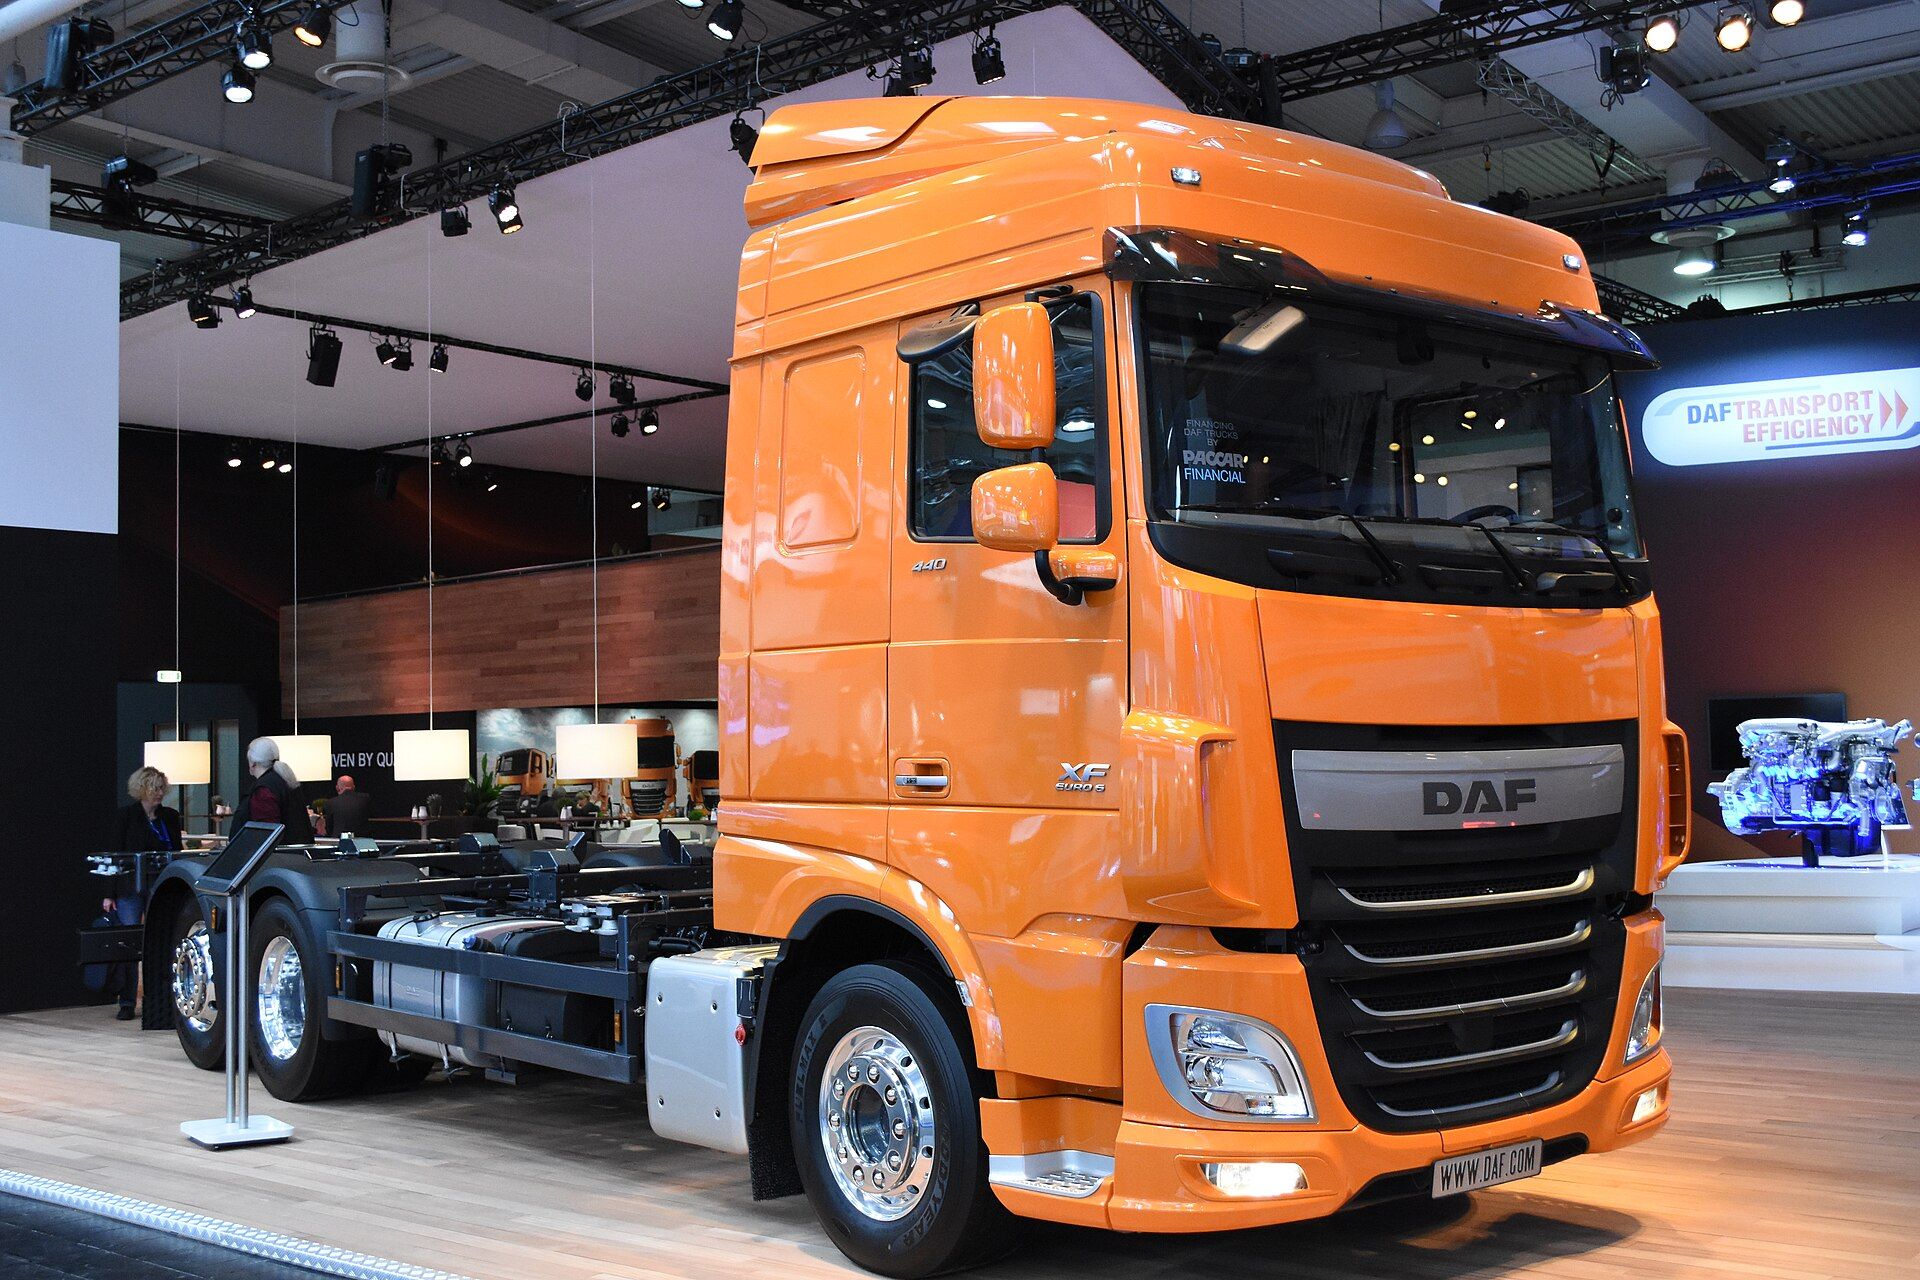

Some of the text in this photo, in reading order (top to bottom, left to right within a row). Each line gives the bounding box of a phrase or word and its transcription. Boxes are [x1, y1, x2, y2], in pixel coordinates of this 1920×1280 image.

[1186, 419, 1234, 431] FINANCING
[1742, 413, 1874, 443] EFFICIENCY
[1184, 428, 1239, 440] DAF TRUCKS
[1207, 438, 1218, 446] BY
[1182, 449, 1245, 469] PACCAR
[1184, 467, 1246, 484] FINANCIAL
[912, 559, 947, 572] 440
[358, 752, 373, 767] BY
[1058, 762, 1111, 782] XF
[1055, 782, 1106, 792] EURO 6
[1423, 779, 1537, 815] DAF
[1440, 1145, 1536, 1192] WWW.DAF.COM
